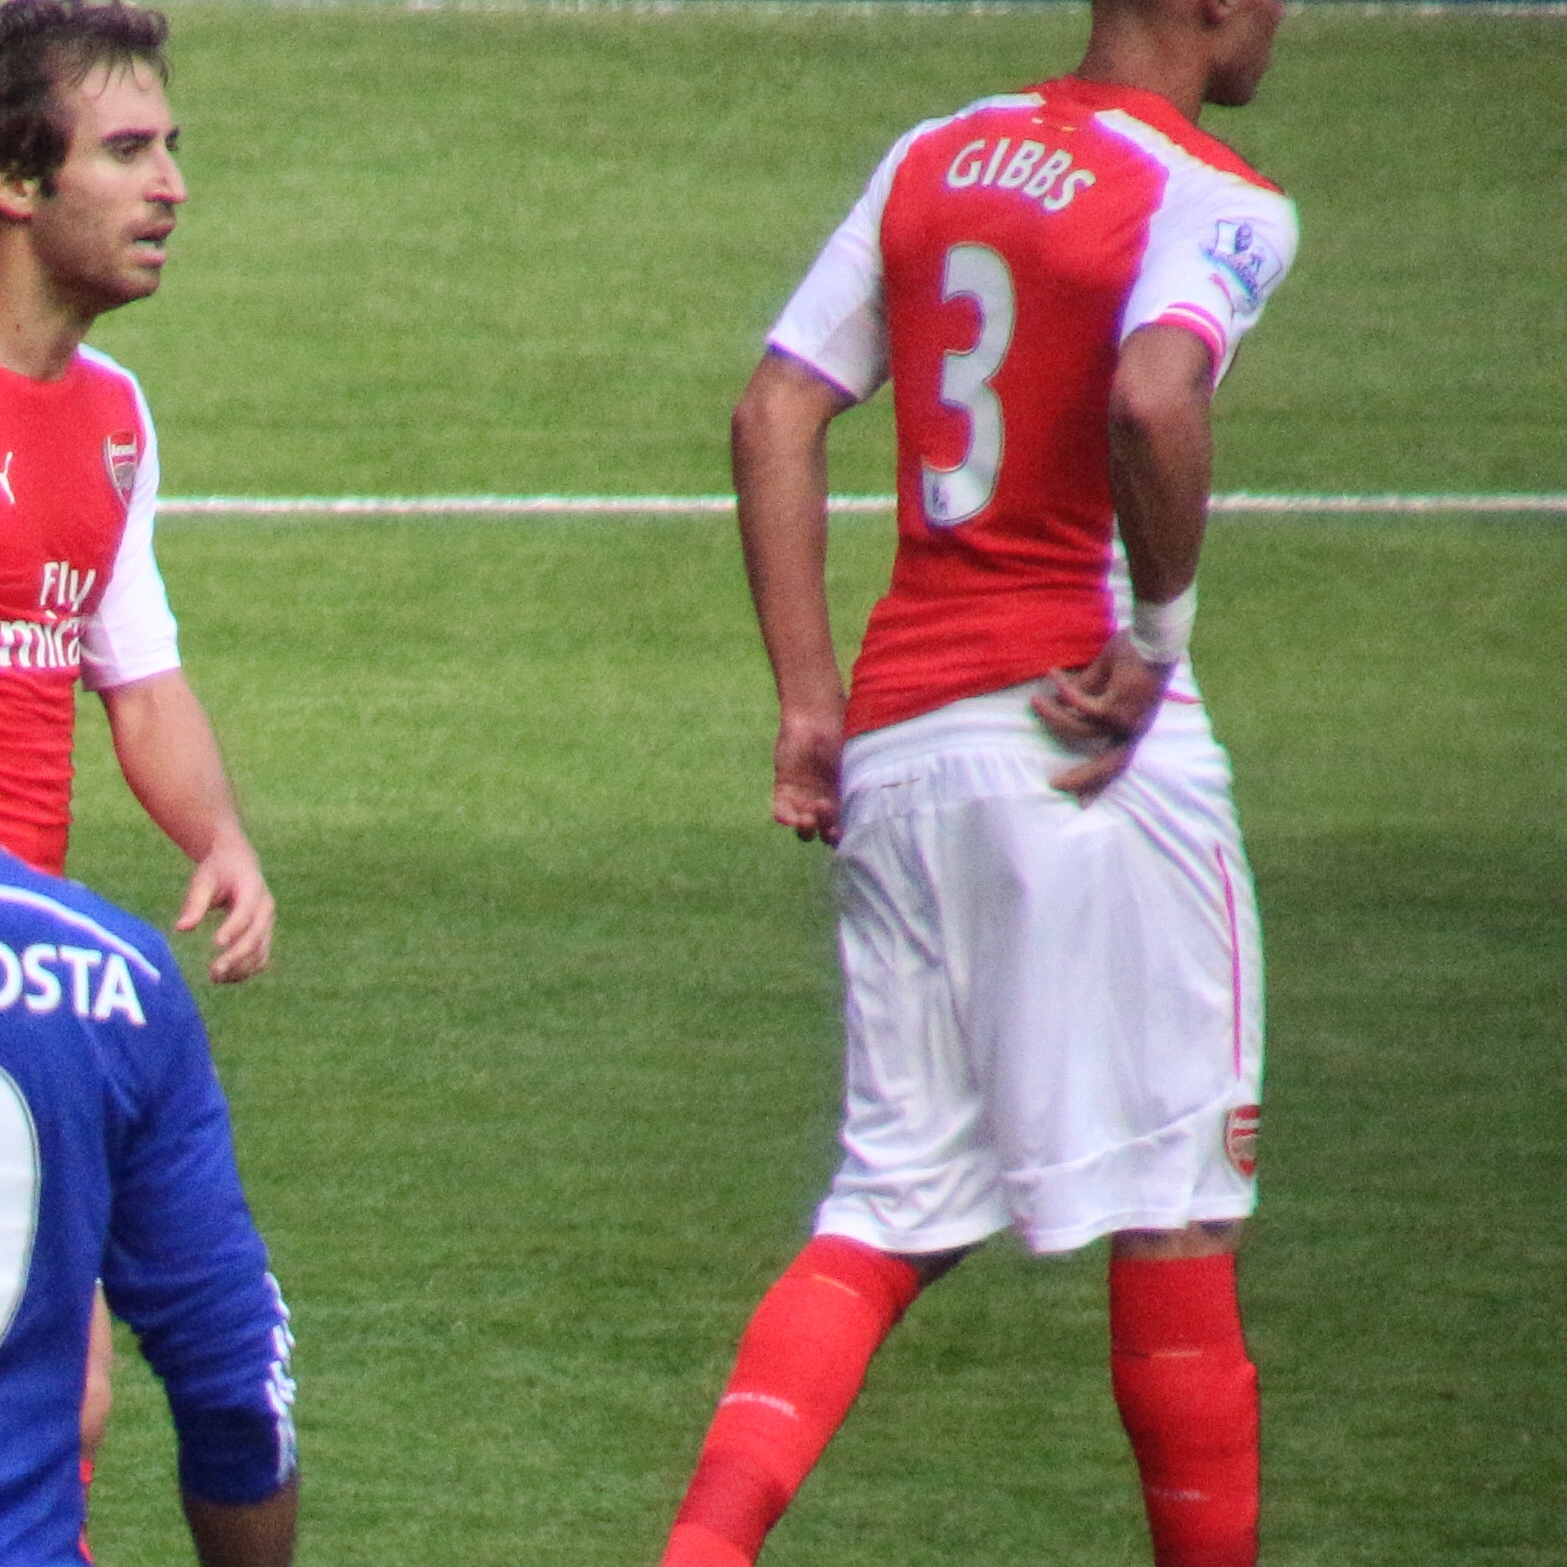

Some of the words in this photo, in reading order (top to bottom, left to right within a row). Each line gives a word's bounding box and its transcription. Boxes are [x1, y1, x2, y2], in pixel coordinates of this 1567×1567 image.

[947, 137, 1096, 211] GIBBS
[921, 242, 1016, 527] 3
[40, 561, 96, 612] Fly
